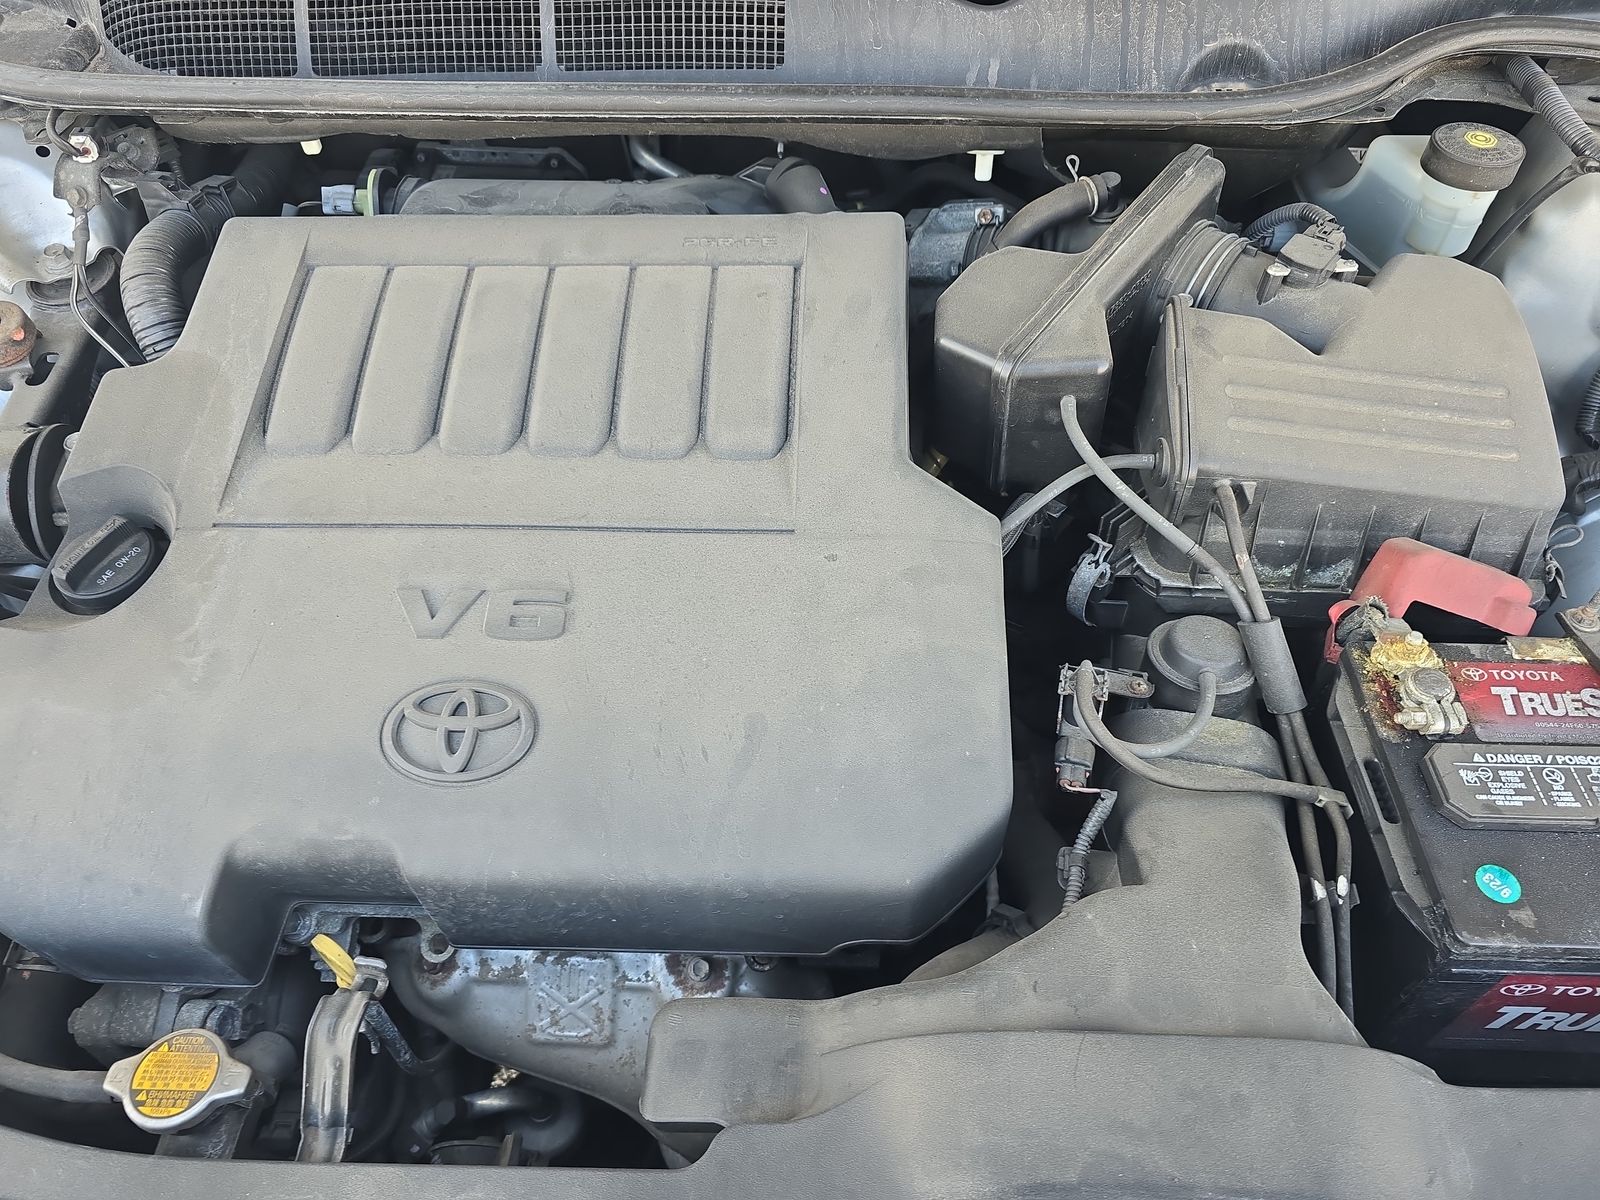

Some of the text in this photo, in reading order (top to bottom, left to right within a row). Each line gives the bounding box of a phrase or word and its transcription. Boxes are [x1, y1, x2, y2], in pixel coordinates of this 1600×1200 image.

[96, 569, 116, 586] SAE
[396, 587, 570, 641] V6
[1488, 669, 1565, 682] TOYOTA
[1486, 753, 1544, 764] DANGER
[1482, 872, 1513, 899] 9/23
[173, 1036, 206, 1044] CAUTION
[169, 1044, 212, 1052] ATTENTION
